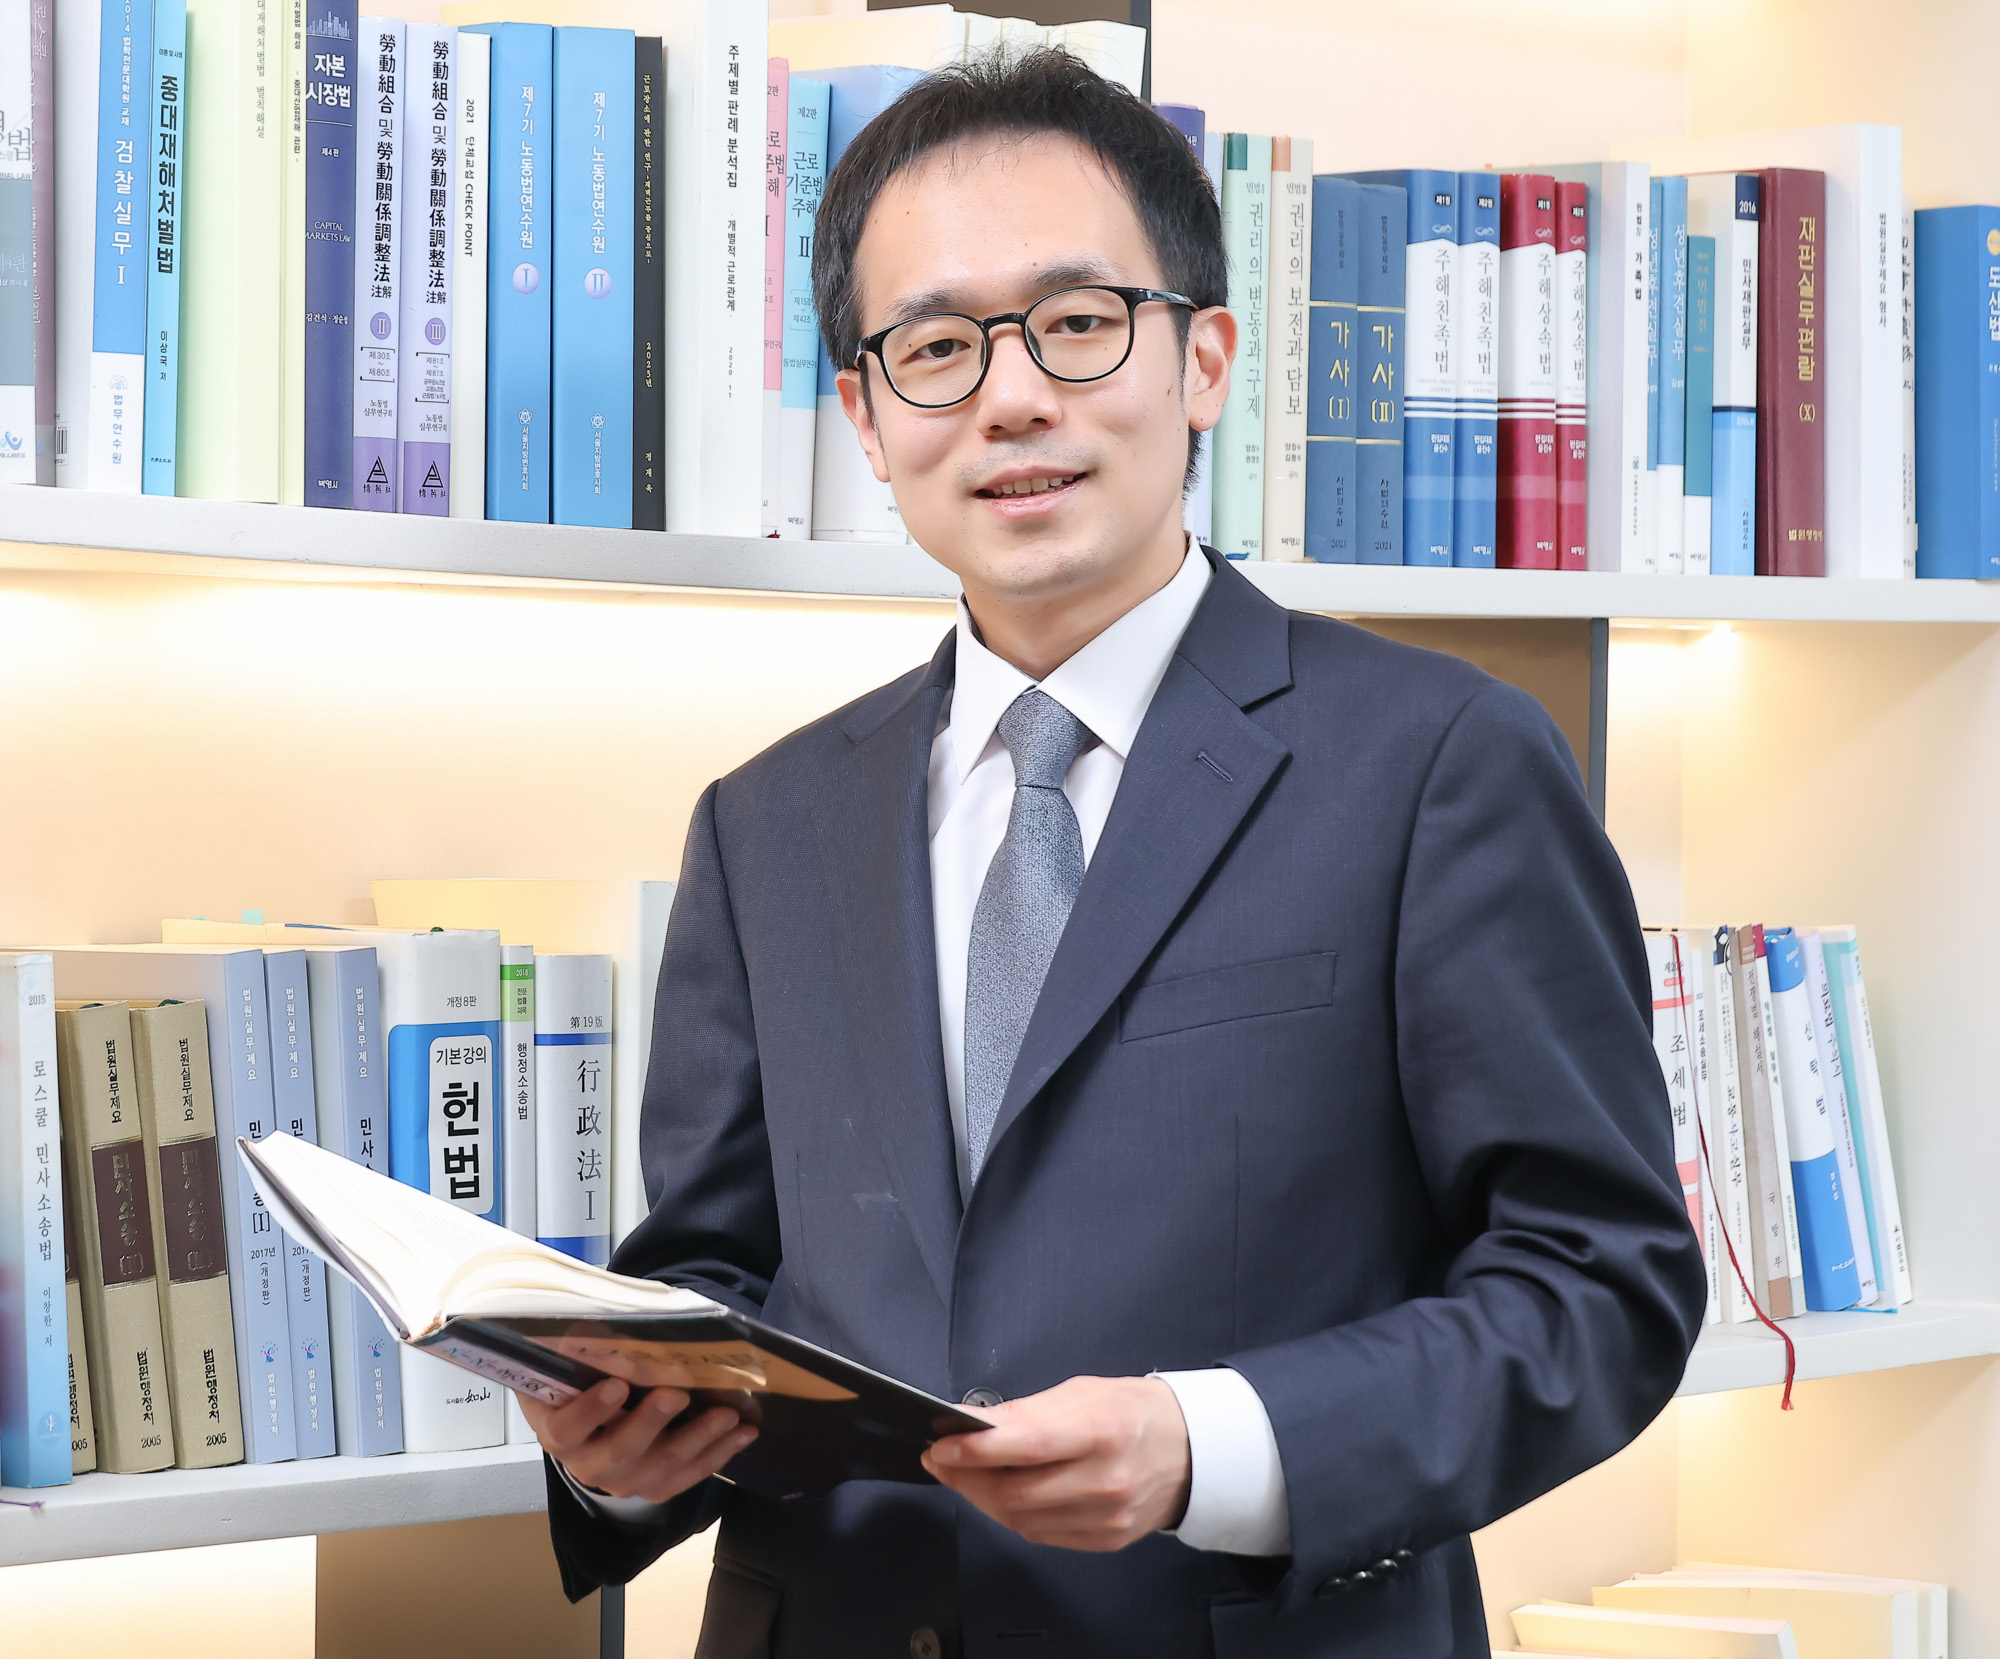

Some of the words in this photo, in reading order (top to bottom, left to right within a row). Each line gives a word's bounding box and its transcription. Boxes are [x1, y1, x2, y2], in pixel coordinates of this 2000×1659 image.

[33, 2, 47, 59] 로스쿨
[159, 49, 168, 57] 이론
[120, 36, 131, 104] 법학전문대학원
[314, 53, 345, 78] 자본
[377, 33, 396, 115] 勞動組合
[432, 40, 449, 121] 勞動組合
[728, 44, 739, 96] 주제별
[120, 107, 131, 127] 교재
[306, 82, 351, 108] 시장법
[466, 99, 474, 124] 2021
[520, 86, 534, 135] 제7기
[592, 90, 606, 141] 제7기
[643, 75, 652, 124] 근로장소에
[727, 100, 739, 133] 판례
[797, 106, 817, 119] 제2판
[378, 118, 393, 138] 및
[433, 125, 446, 145] 및
[643, 128, 652, 148] 관한
[157, 75, 179, 274] 중대재해처벌법
[321, 147, 340, 158] 제4판
[465, 136, 474, 179] 단체교섭
[644, 151, 652, 171] 연구
[727, 139, 738, 188] 분석집
[793, 151, 819, 170] 근로
[111, 139, 134, 255] 검찰실무
[464, 184, 473, 220] CHECK
[519, 140, 534, 250] 노동법연수원
[591, 145, 606, 254] 노동법연수원
[786, 173, 822, 197] 기준법
[1739, 200, 1756, 214] 2016
[314, 221, 344, 231] CAPITAL
[373, 141, 394, 282] 勞動關係調整法
[428, 148, 447, 288] 勞動關係調整法
[791, 198, 817, 218] 주해
[339, 234, 351, 243] LAW
[463, 224, 472, 257] POINT
[727, 219, 736, 258] 개별적
[1249, 201, 1264, 281] 권리의
[1289, 202, 1304, 281] 권리의
[726, 261, 736, 312] 근로관계
[1673, 224, 1686, 361] 성년후견실무
[1742, 259, 1751, 350] 민사재판실무
[1797, 216, 1816, 382] 재판실무편람
[793, 314, 811, 324] 제42조
[1247, 284, 1262, 364] 변동과
[1288, 286, 1304, 364] 보전과
[1434, 249, 1450, 374] 주해친족법
[1477, 251, 1493, 375] 주해친족법
[1538, 253, 1552, 375] 주해상속법
[160, 331, 168, 366] 이상국
[369, 351, 391, 360] 제30조
[426, 357, 444, 365] 제81조
[645, 341, 653, 389] 2023년
[1330, 321, 1350, 387] 가사
[1372, 324, 1394, 391] 가사
[160, 372, 167, 381] 저
[368, 368, 391, 377] 제80조
[425, 369, 444, 377] 제87조
[1246, 369, 1261, 420] 구제
[1285, 367, 1302, 415] 담보
[363, 408, 393, 418] 실무연구회
[370, 399, 388, 408] 노동법
[425, 414, 443, 423] 노동법
[112, 394, 123, 464] 법무연수원
[418, 422, 448, 432] 실무연구회
[521, 426, 529, 490] 서울지방변호사회
[593, 430, 602, 495] 서울지방변호사회
[318, 479, 338, 489] 박영사
[788, 516, 804, 525] 박영사
[887, 505, 900, 514] 박영
[1242, 539, 1259, 548] 박영사
[1281, 537, 1300, 546] 박영사
[1331, 539, 1347, 549] 2021
[1375, 541, 1392, 550] 2021
[516, 969, 528, 977] 2018
[28, 994, 46, 1007] 2015
[242, 988, 258, 1081] 법원실무제요
[285, 987, 299, 1080] 법원실무제요
[355, 986, 368, 1079] 법원실무제요
[436, 1045, 488, 1066] 기본강의
[33, 1060, 48, 1128] 로스쿨
[105, 1039, 122, 1124] 법원실무제요
[179, 1038, 195, 1122] 법원실무제요
[516, 1042, 528, 1120] 행정소송법
[1670, 1034, 1687, 1127] 조세법
[441, 1081, 481, 1200] 헌법
[576, 1058, 602, 1182] 行政法
[36, 1145, 52, 1262] 민사소송법
[250, 1246, 276, 1260] 2017년
[260, 1261, 271, 1306] (개정판)
[42, 1287, 52, 1327] 이창한
[44, 1334, 53, 1347] 저
[137, 1350, 154, 1426] 법원행정처
[203, 1348, 220, 1424] 법원행정처
[267, 1372, 280, 1436] 법원행정처
[306, 1367, 319, 1431] 법원행정처
[373, 1367, 384, 1430] 법원행정처
[446, 1397, 464, 1405] 도서출판
[71, 1438, 88, 1451] 005
[140, 1434, 162, 1449] 2005
[206, 1433, 228, 1447] 2005
